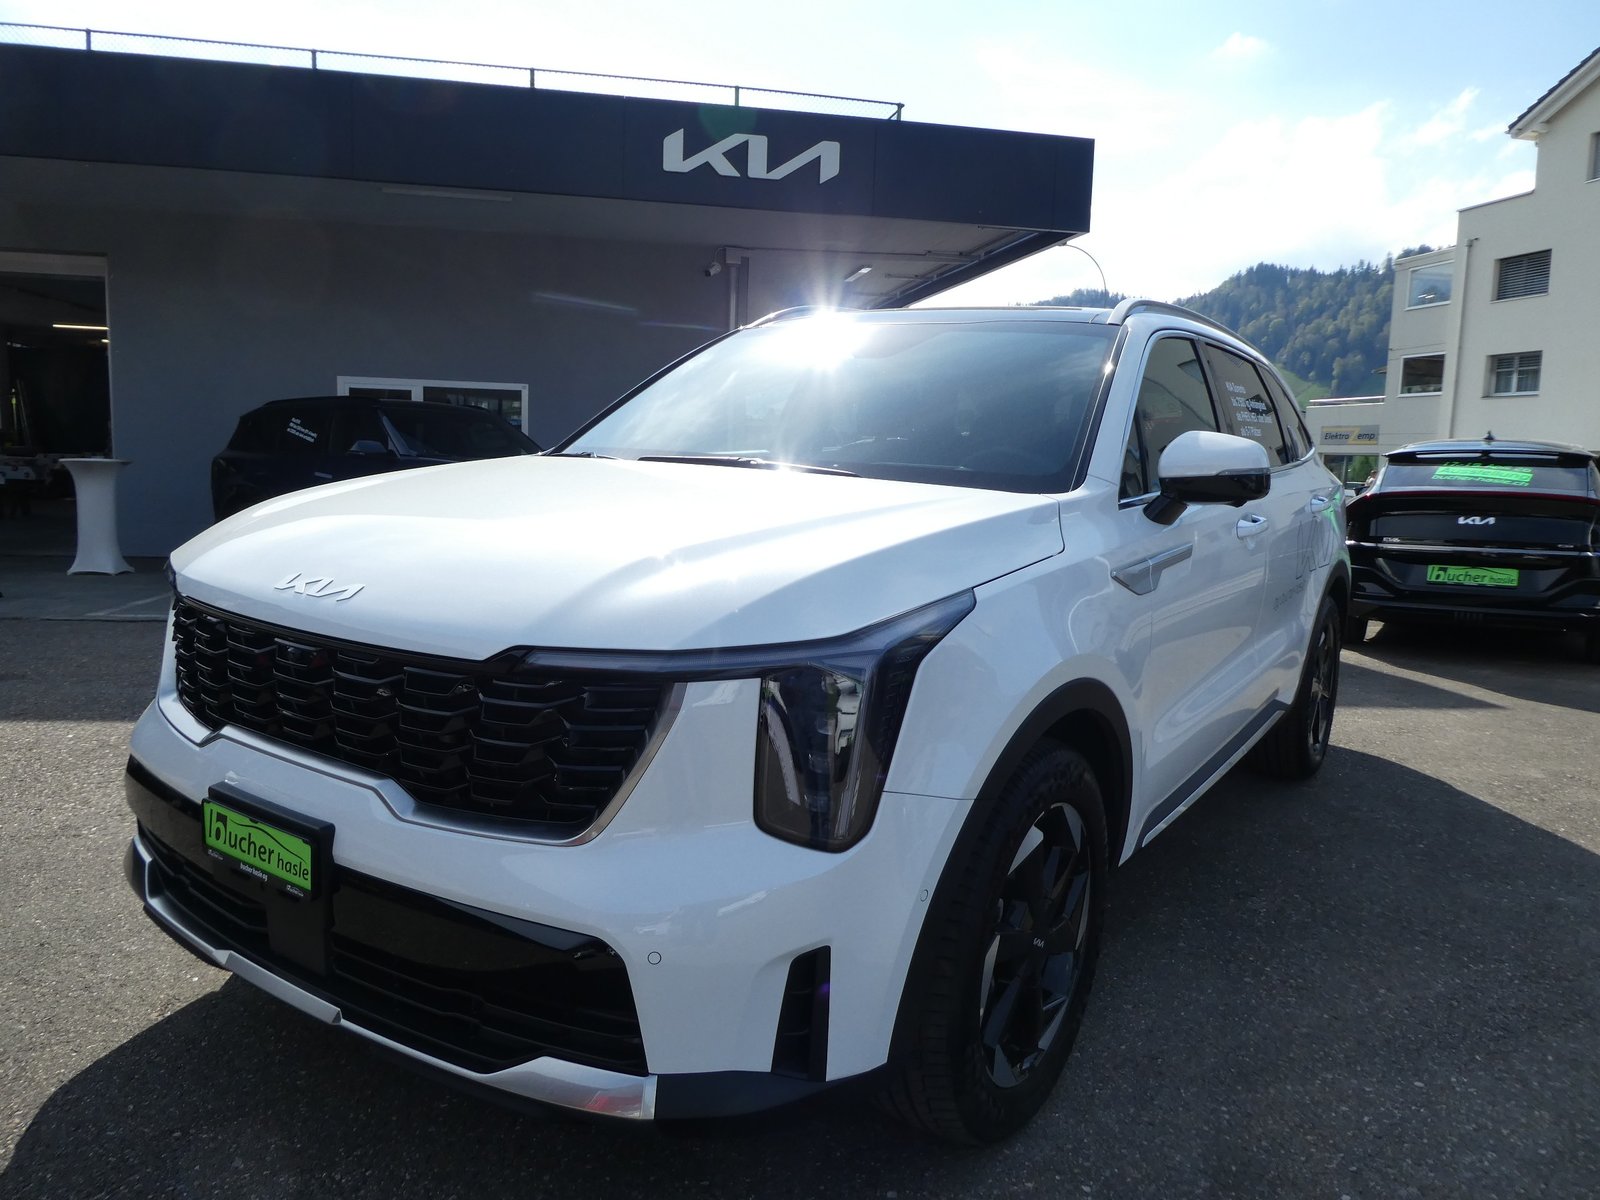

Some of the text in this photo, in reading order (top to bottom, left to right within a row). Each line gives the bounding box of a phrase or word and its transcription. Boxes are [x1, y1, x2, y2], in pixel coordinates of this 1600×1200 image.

[662, 128, 841, 185] KIA
[1324, 432, 1350, 440] Elektro
[1457, 516, 1496, 525] KIA
[1429, 566, 1488, 583] bucher
[273, 571, 367, 603] KIA
[208, 808, 309, 880] bucher hasle
